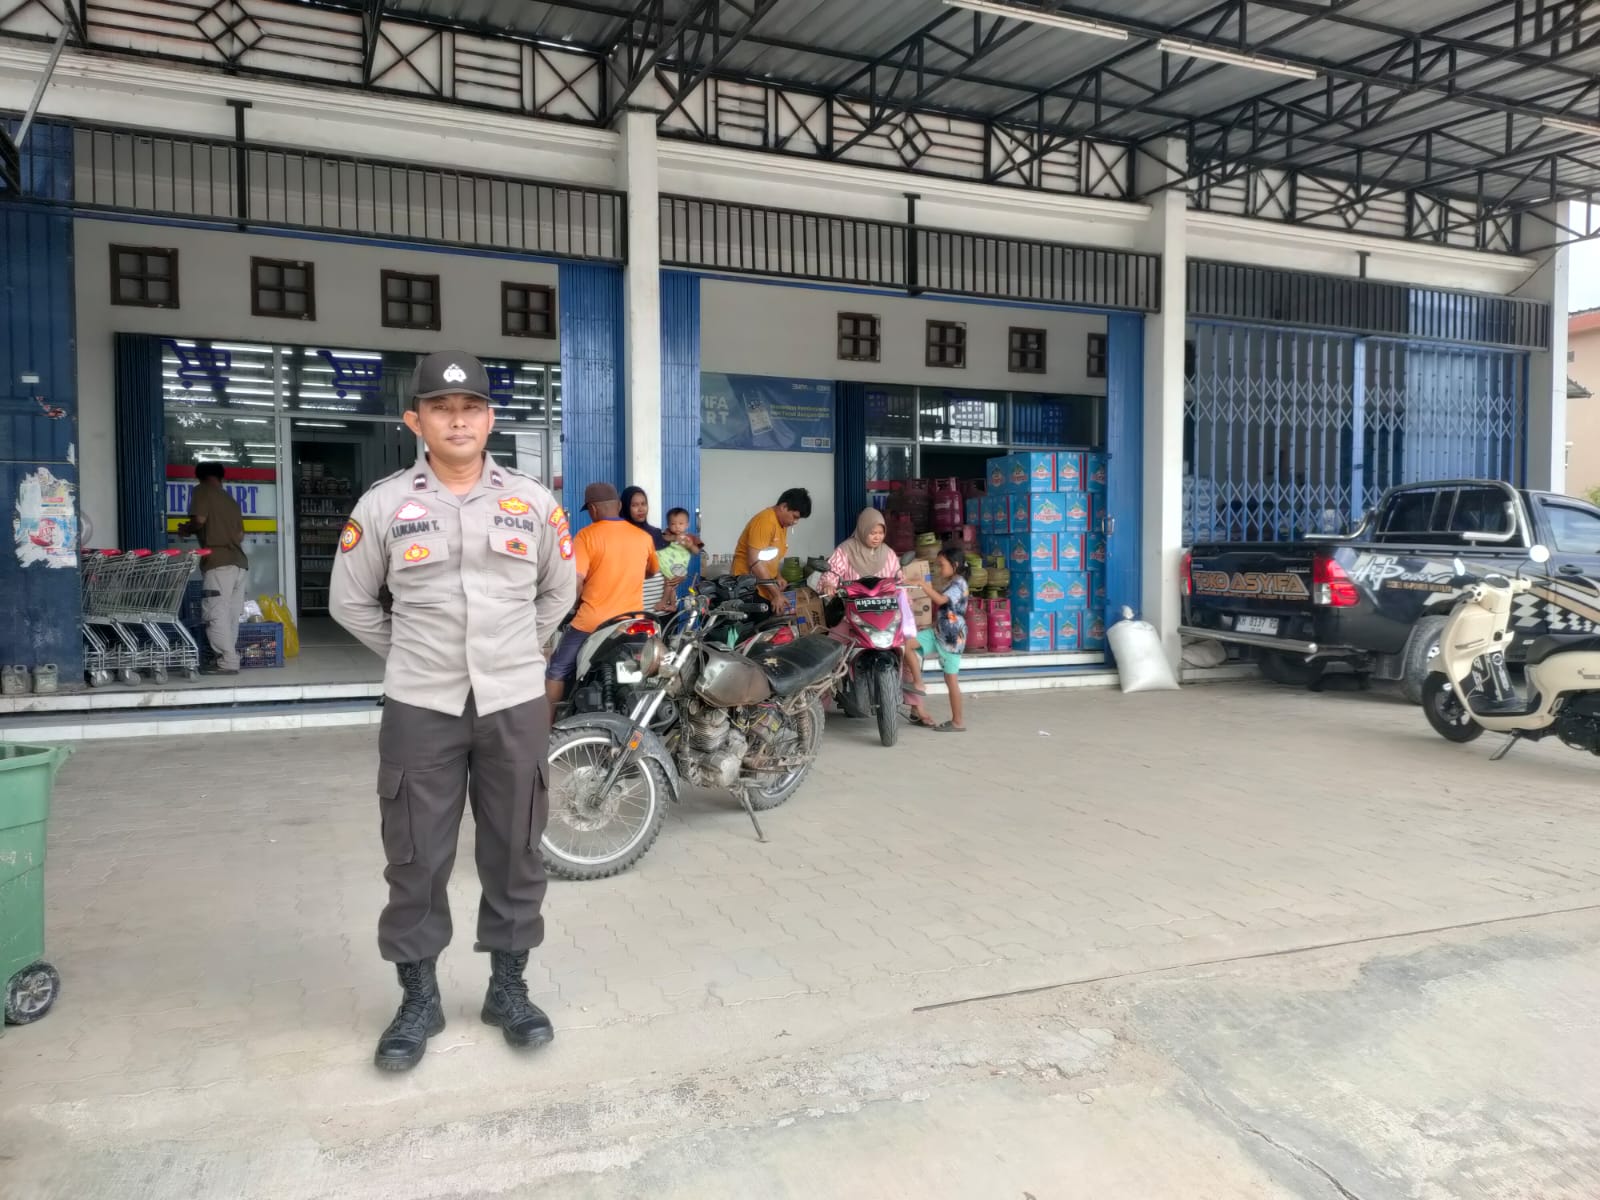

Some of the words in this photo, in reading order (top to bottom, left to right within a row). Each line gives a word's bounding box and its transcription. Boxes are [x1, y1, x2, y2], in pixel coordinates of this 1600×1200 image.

[702, 395, 729, 410] IFA
[392, 521, 430, 538] LUKMAN
[494, 515, 534, 533] POLRI
[1195, 571, 1229, 592] TOKO
[1230, 572, 1308, 595] ASYIFA
